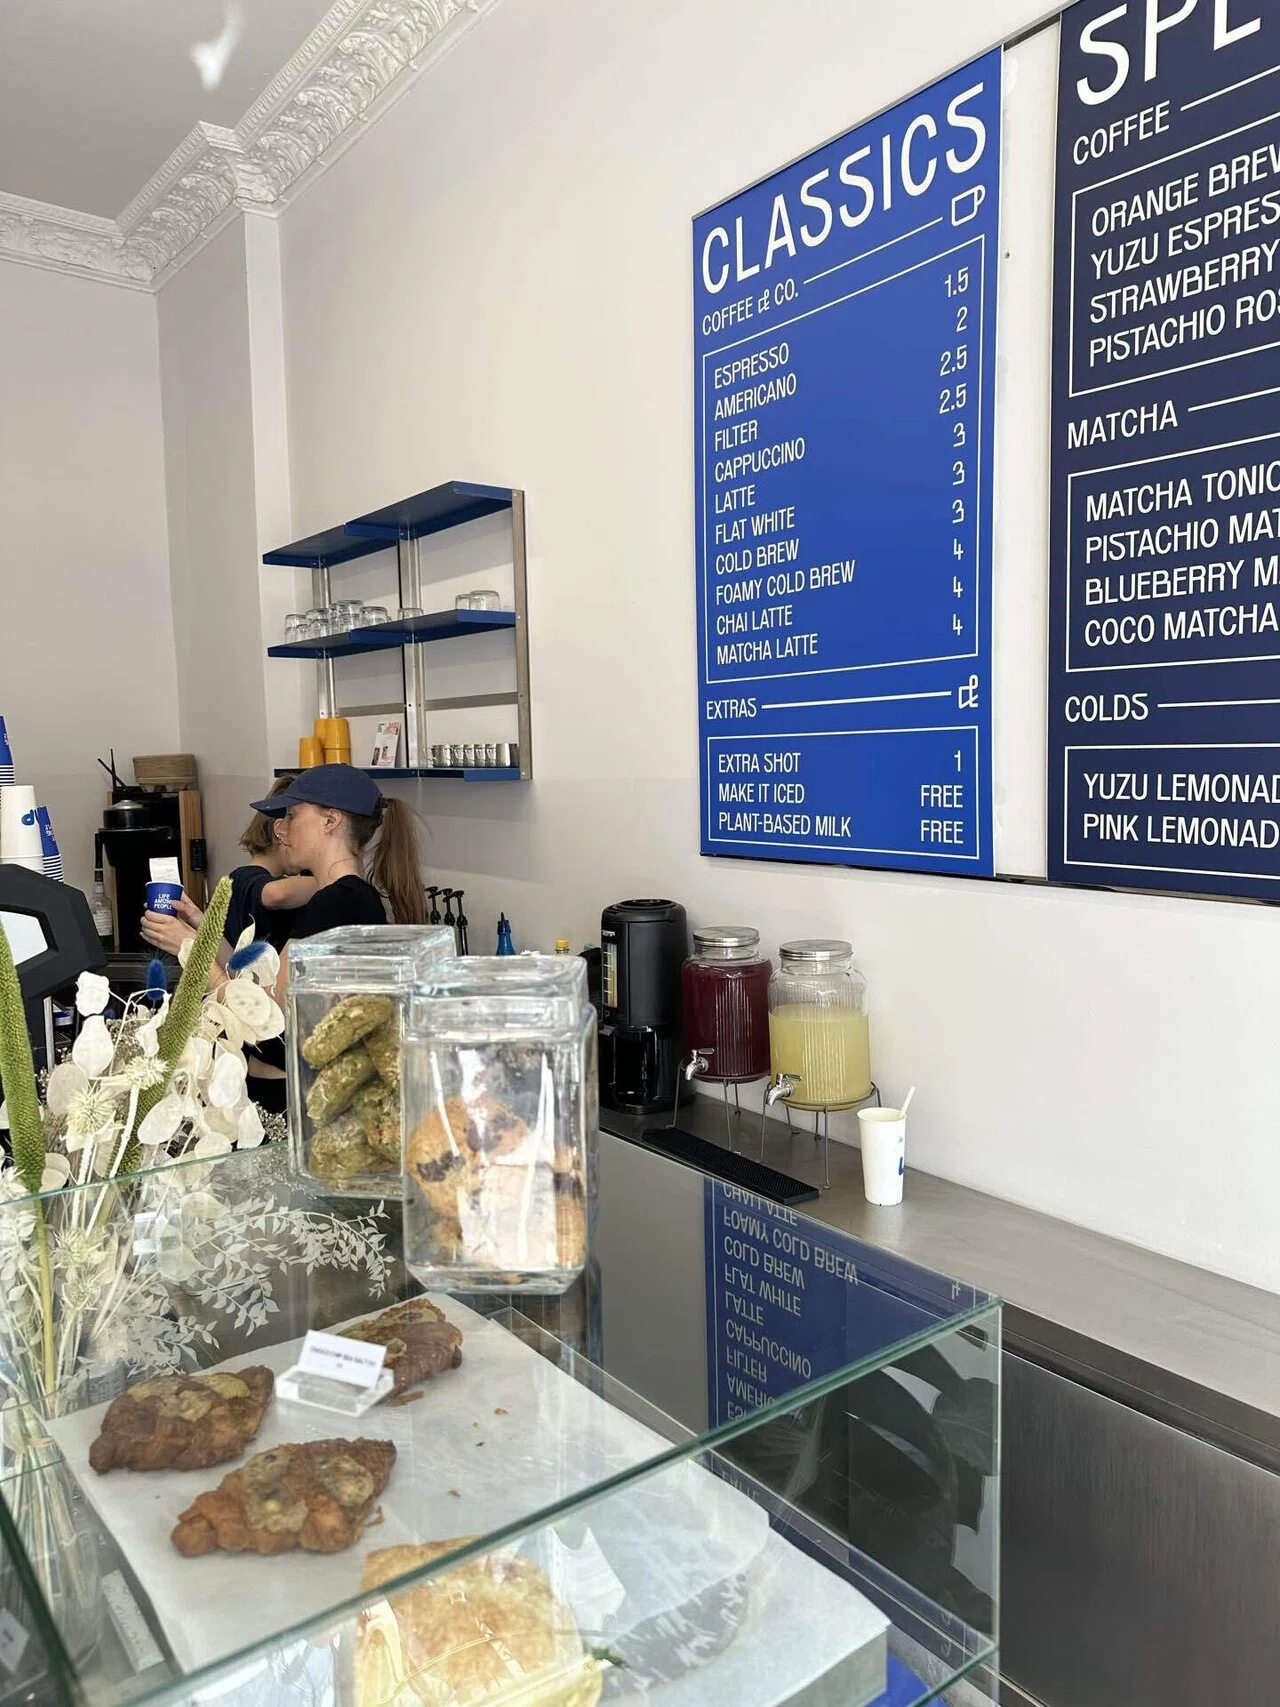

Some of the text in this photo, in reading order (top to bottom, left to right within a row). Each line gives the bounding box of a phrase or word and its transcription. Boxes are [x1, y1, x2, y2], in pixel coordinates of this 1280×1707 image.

[1074, 100, 1169, 164] COFFEE
[703, 82, 985, 293] CLASSICS
[1092, 173, 1198, 236] ORANGE
[1091, 233, 1158, 279] YUZU
[1091, 239, 1280, 323] STRAWBERRY
[703, 297, 753, 335] COFFEE
[775, 279, 798, 305] CO.
[715, 267, 968, 389] ESPRESSO 1.5
[1090, 290, 1280, 367] PISTACHIO RO
[715, 307, 967, 420] AMERICANO 2
[716, 345, 966, 451] FILTER 2.5
[1068, 400, 1177, 449] MATCHA
[716, 383, 966, 482] CAPPUCCINO 2.5
[716, 423, 965, 513] LATTE 3
[1087, 461, 1280, 522] MATCHA TONIC
[716, 461, 964, 544] FLAT WHITE 3
[716, 500, 964, 574] COLD BREW 3
[1087, 519, 1218, 563] PISTACHIO
[717, 539, 963, 604] FOAMY COLD BREW 4
[1086, 560, 1244, 605] BLUEBERRY
[717, 577, 963, 635] CHAI LATTE 4
[1085, 603, 1278, 646] COCO MATCHA
[718, 614, 962, 664] MATCHA LATTE 4
[707, 698, 756, 719] EXTRAS
[1065, 693, 1148, 722] COLDS
[719, 751, 960, 772] EXTRA SHOT 1
[1084, 774, 1147, 800] YUZU
[719, 784, 962, 807] MAKE IT ICED FREE
[720, 812, 963, 843] PLANT-BASED MILK FREE
[1084, 814, 1279, 848] PINK LEMONAD
